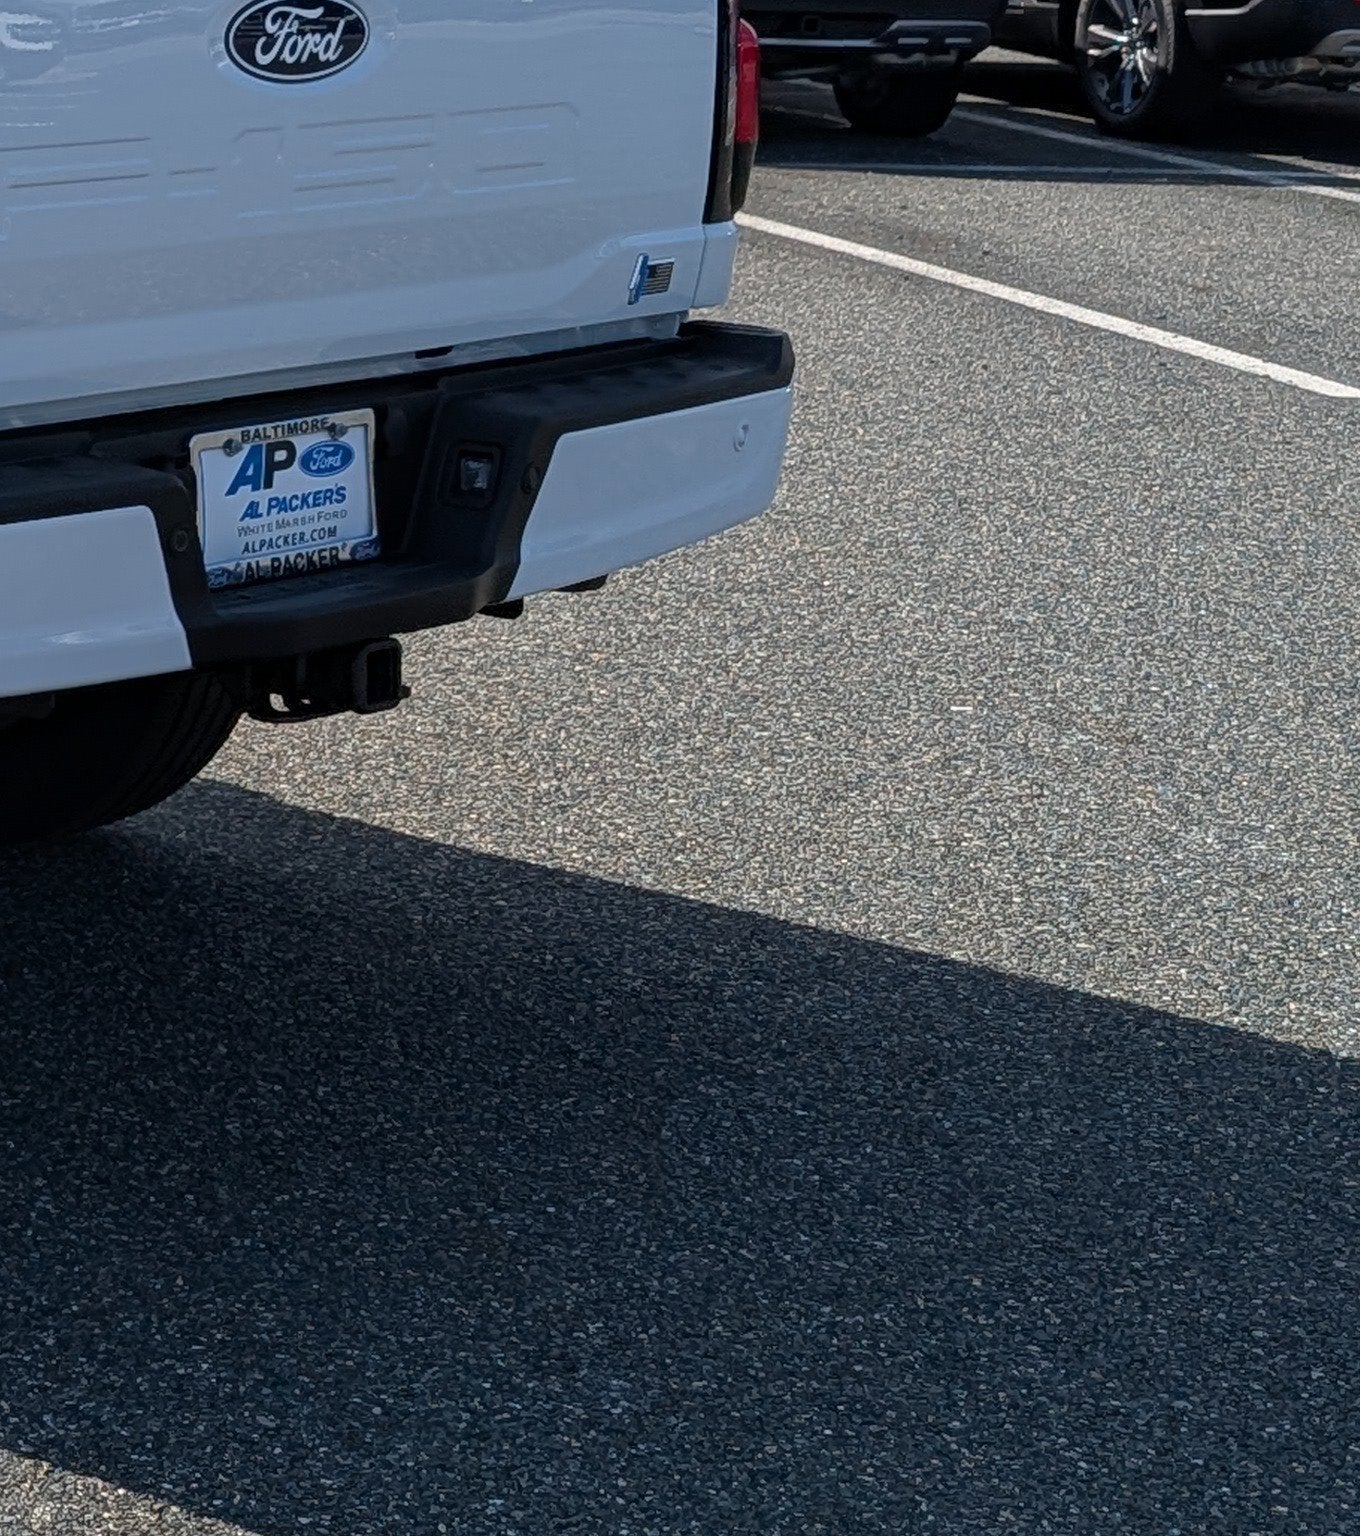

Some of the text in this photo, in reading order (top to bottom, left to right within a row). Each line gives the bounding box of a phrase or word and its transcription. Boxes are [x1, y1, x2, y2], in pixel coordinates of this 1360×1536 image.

[255, 6, 343, 65] Ford
[240, 416, 330, 444] BALTIMORE
[224, 440, 297, 497] AP
[239, 483, 347, 522] AL PACKER'S
[241, 525, 338, 555] ALPACKER.COM
